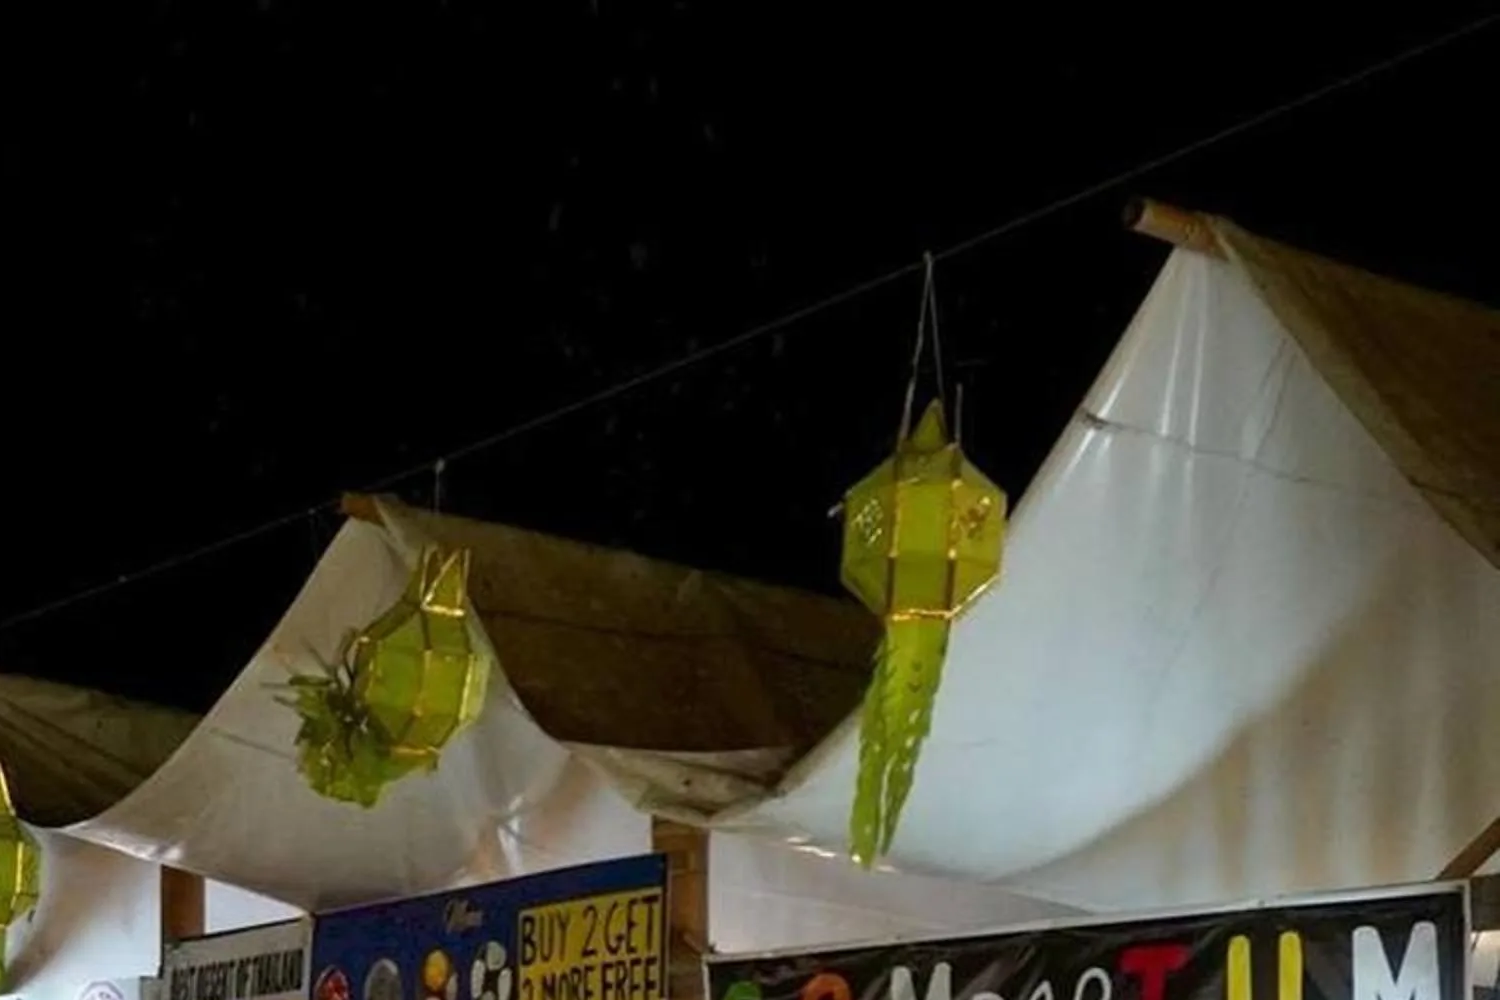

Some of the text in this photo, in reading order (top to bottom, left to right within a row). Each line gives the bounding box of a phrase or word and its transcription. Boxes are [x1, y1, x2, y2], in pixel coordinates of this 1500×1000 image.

[522, 909, 569, 966] BUY
[582, 904, 598, 957] 2
[604, 895, 660, 955] GET
